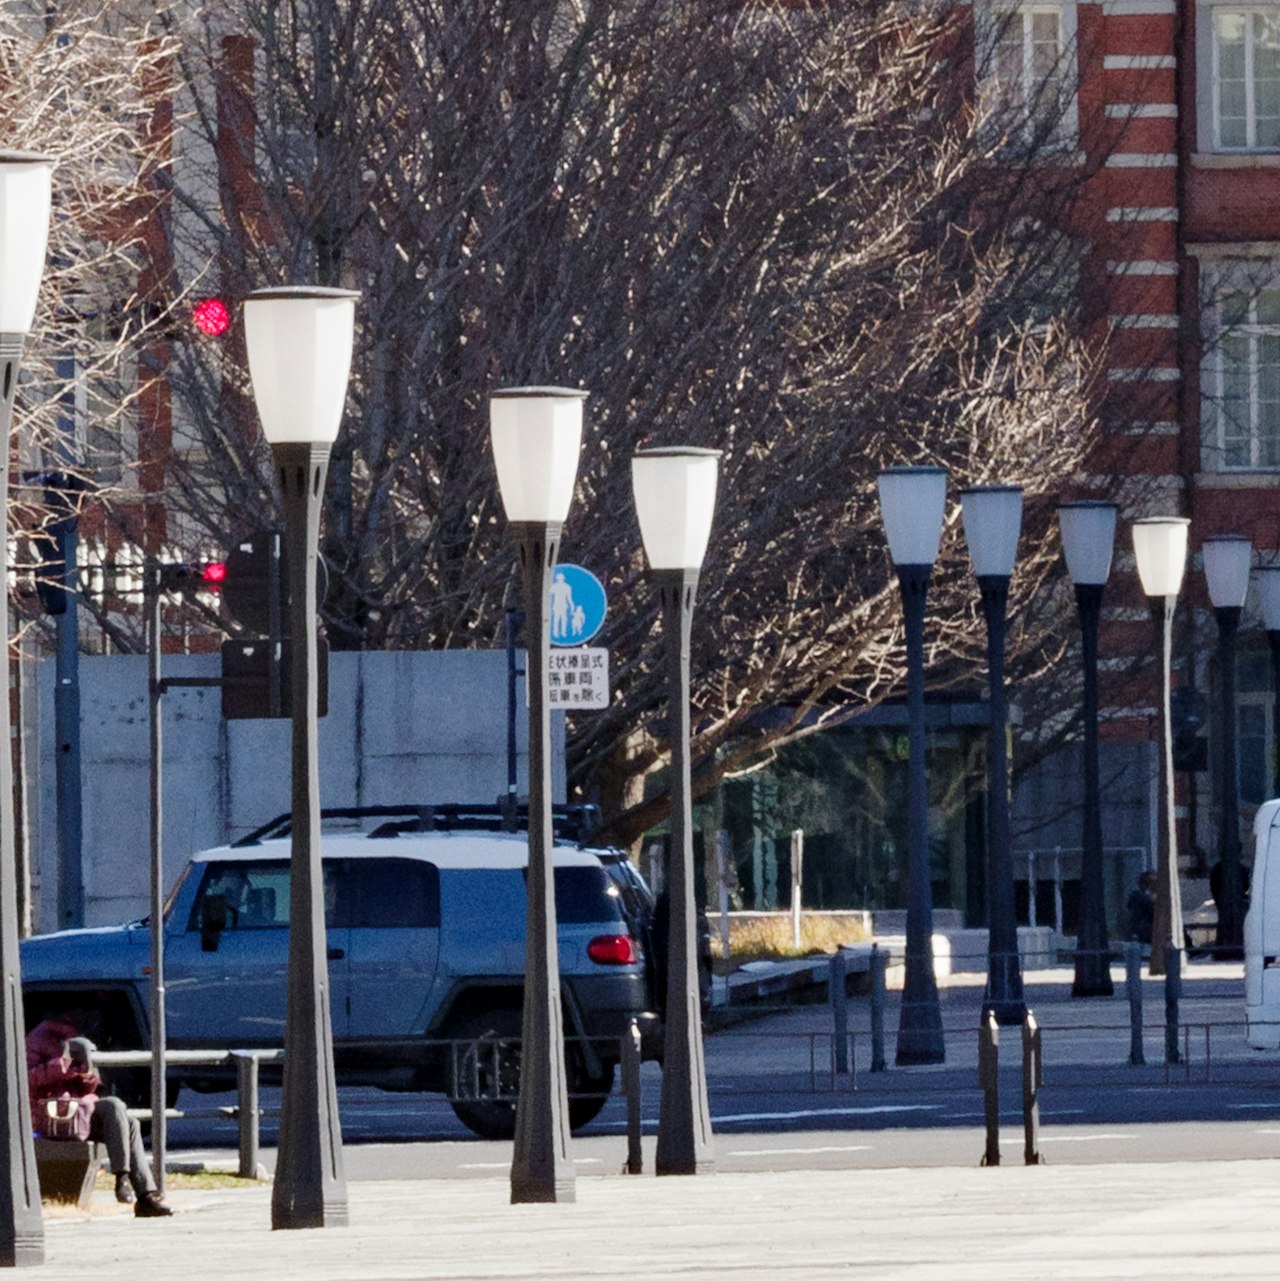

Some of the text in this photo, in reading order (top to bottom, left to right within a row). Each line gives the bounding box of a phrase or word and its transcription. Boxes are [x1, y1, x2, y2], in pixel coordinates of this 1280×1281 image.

[549, 672, 601, 686] 係車両・
[549, 688, 602, 702] 転車を除く
